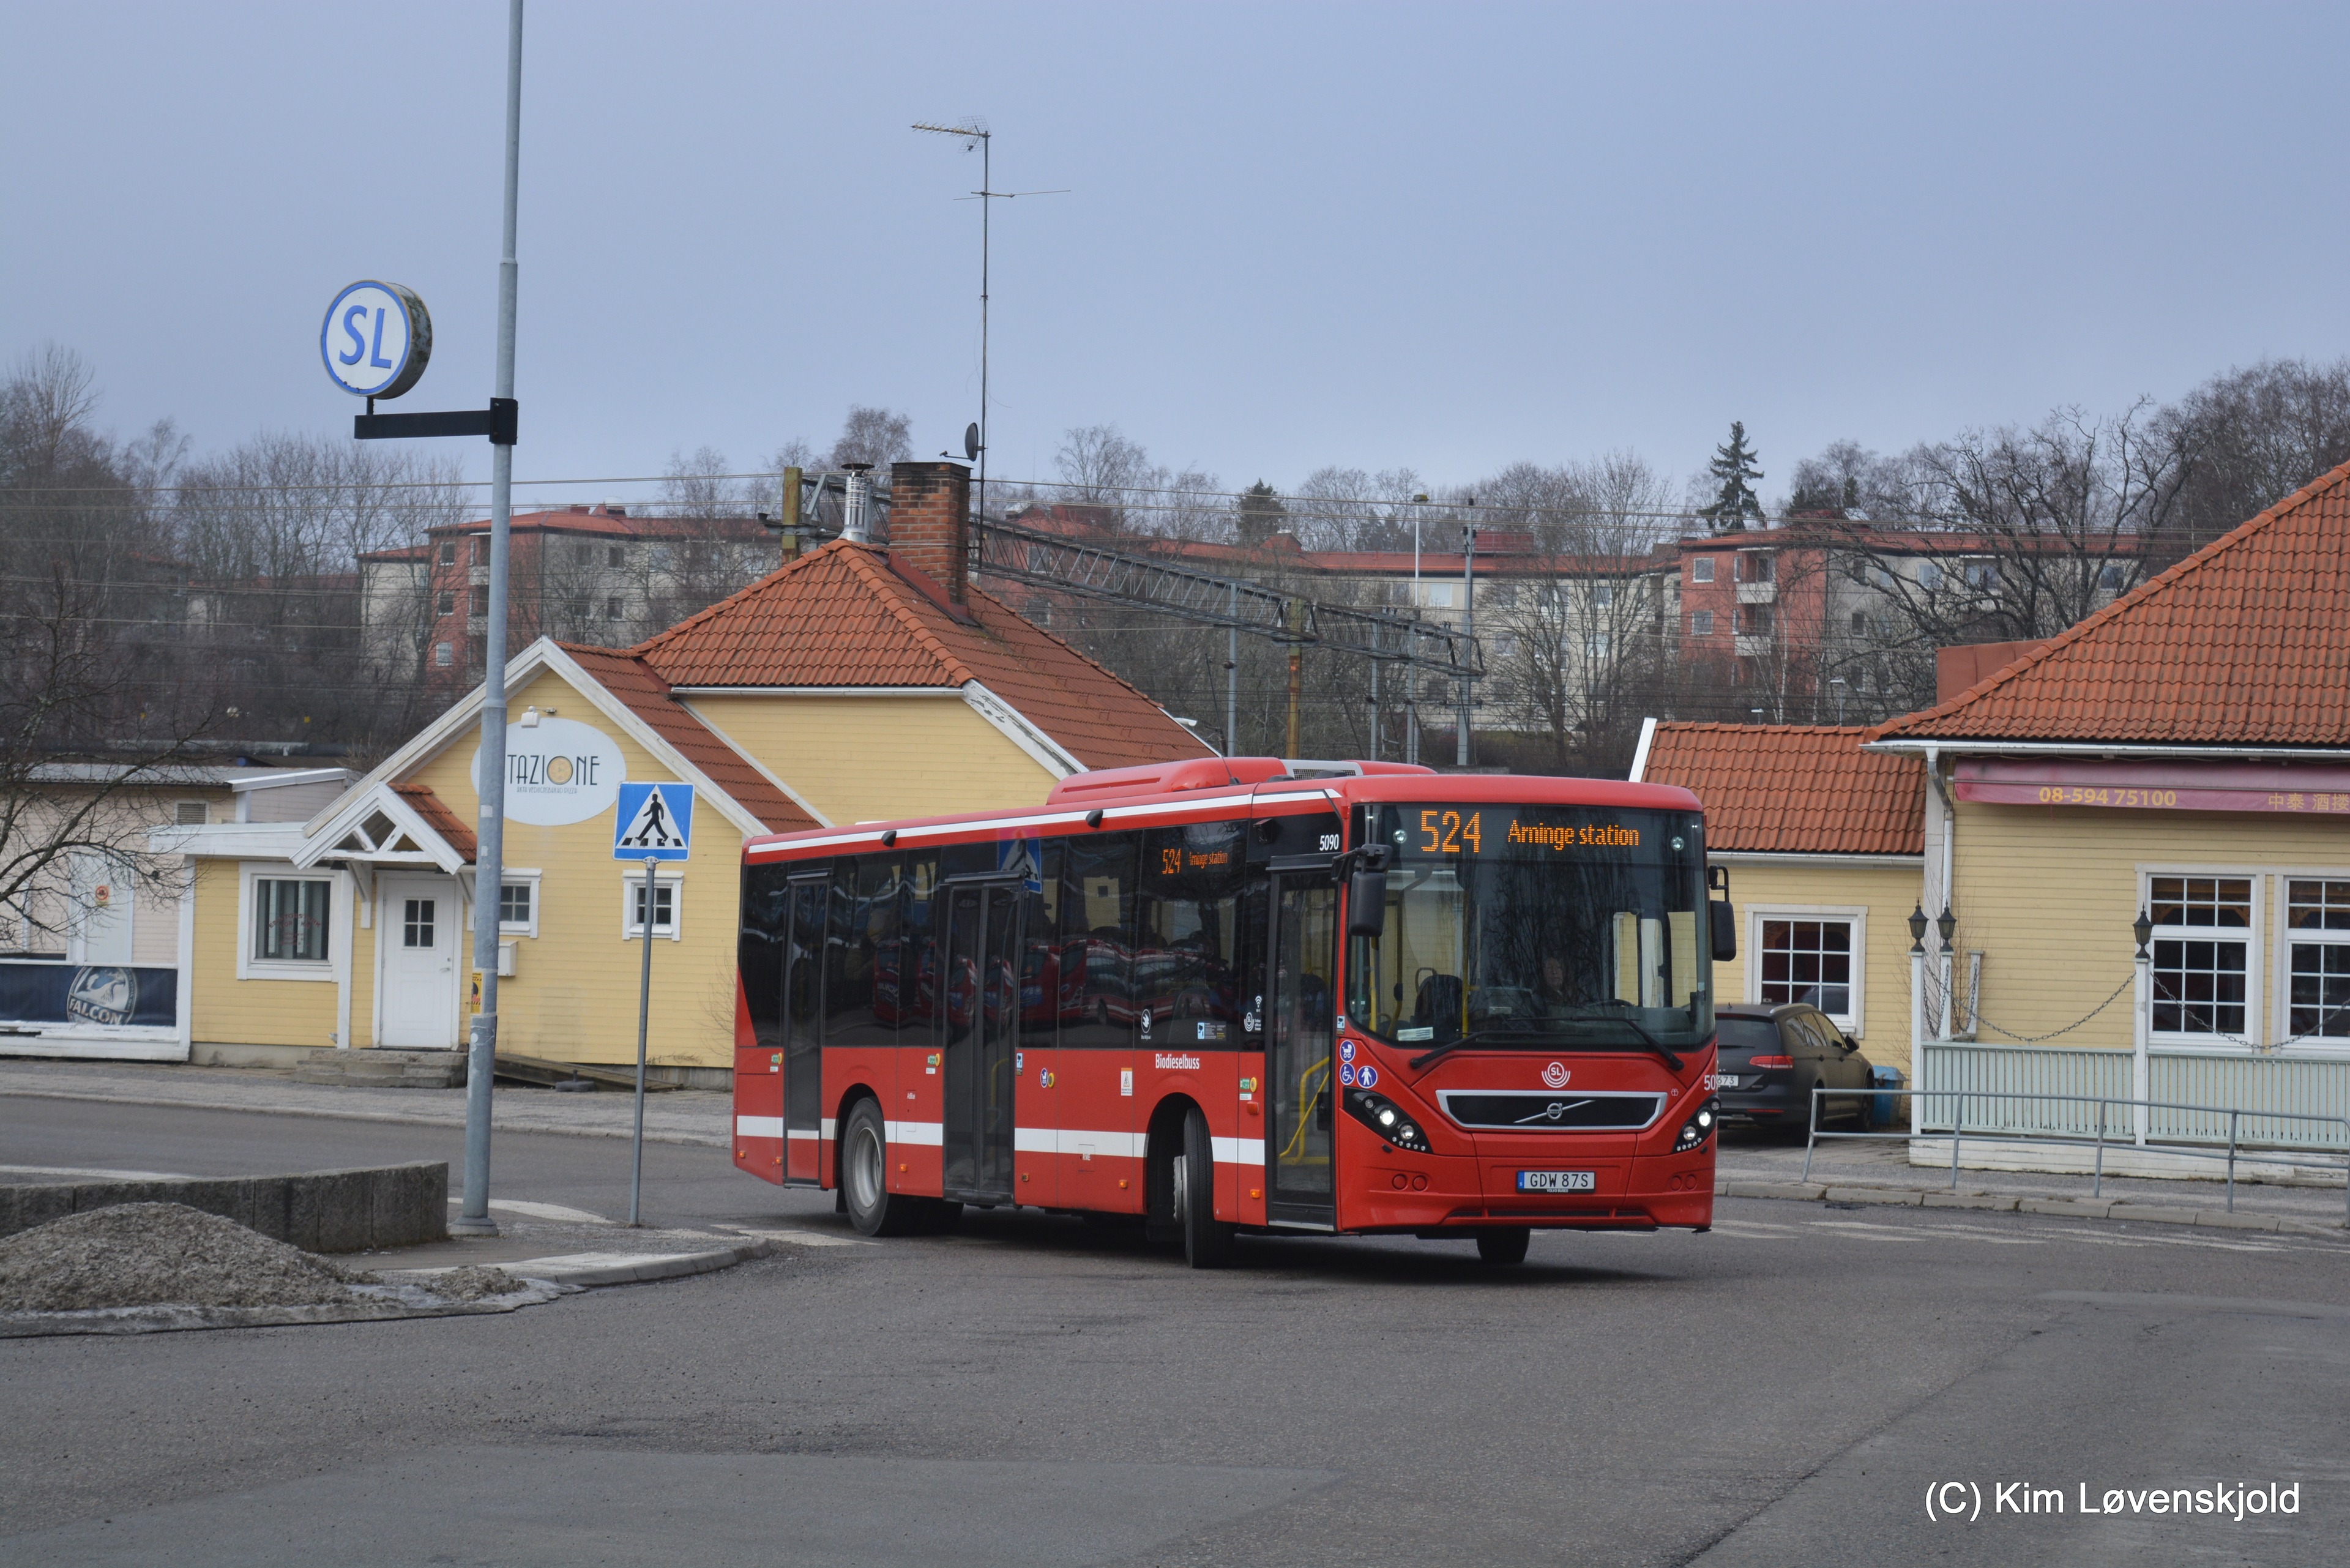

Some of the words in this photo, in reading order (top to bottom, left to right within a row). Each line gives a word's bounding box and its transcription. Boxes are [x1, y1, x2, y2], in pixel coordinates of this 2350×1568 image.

[339, 305, 392, 369] SL
[505, 755, 600, 785] TAZIONE
[2039, 787, 2109, 804] 08-594
[2114, 790, 2176, 806] 75100
[1421, 811, 1480, 853] 524
[1508, 820, 1575, 851] Arninge
[1579, 824, 1639, 846] station
[1319, 834, 1339, 851] 5090
[1162, 848, 1181, 874] 524
[69, 998, 123, 1025] FALCON
[1155, 1053, 1199, 1069] Biodieselbuss
[1551, 1067, 1561, 1076] SL
[1704, 1075, 1718, 1091] 50
[1530, 1173, 1557, 1187] GDW
[1562, 1174, 1588, 1187] 87S
